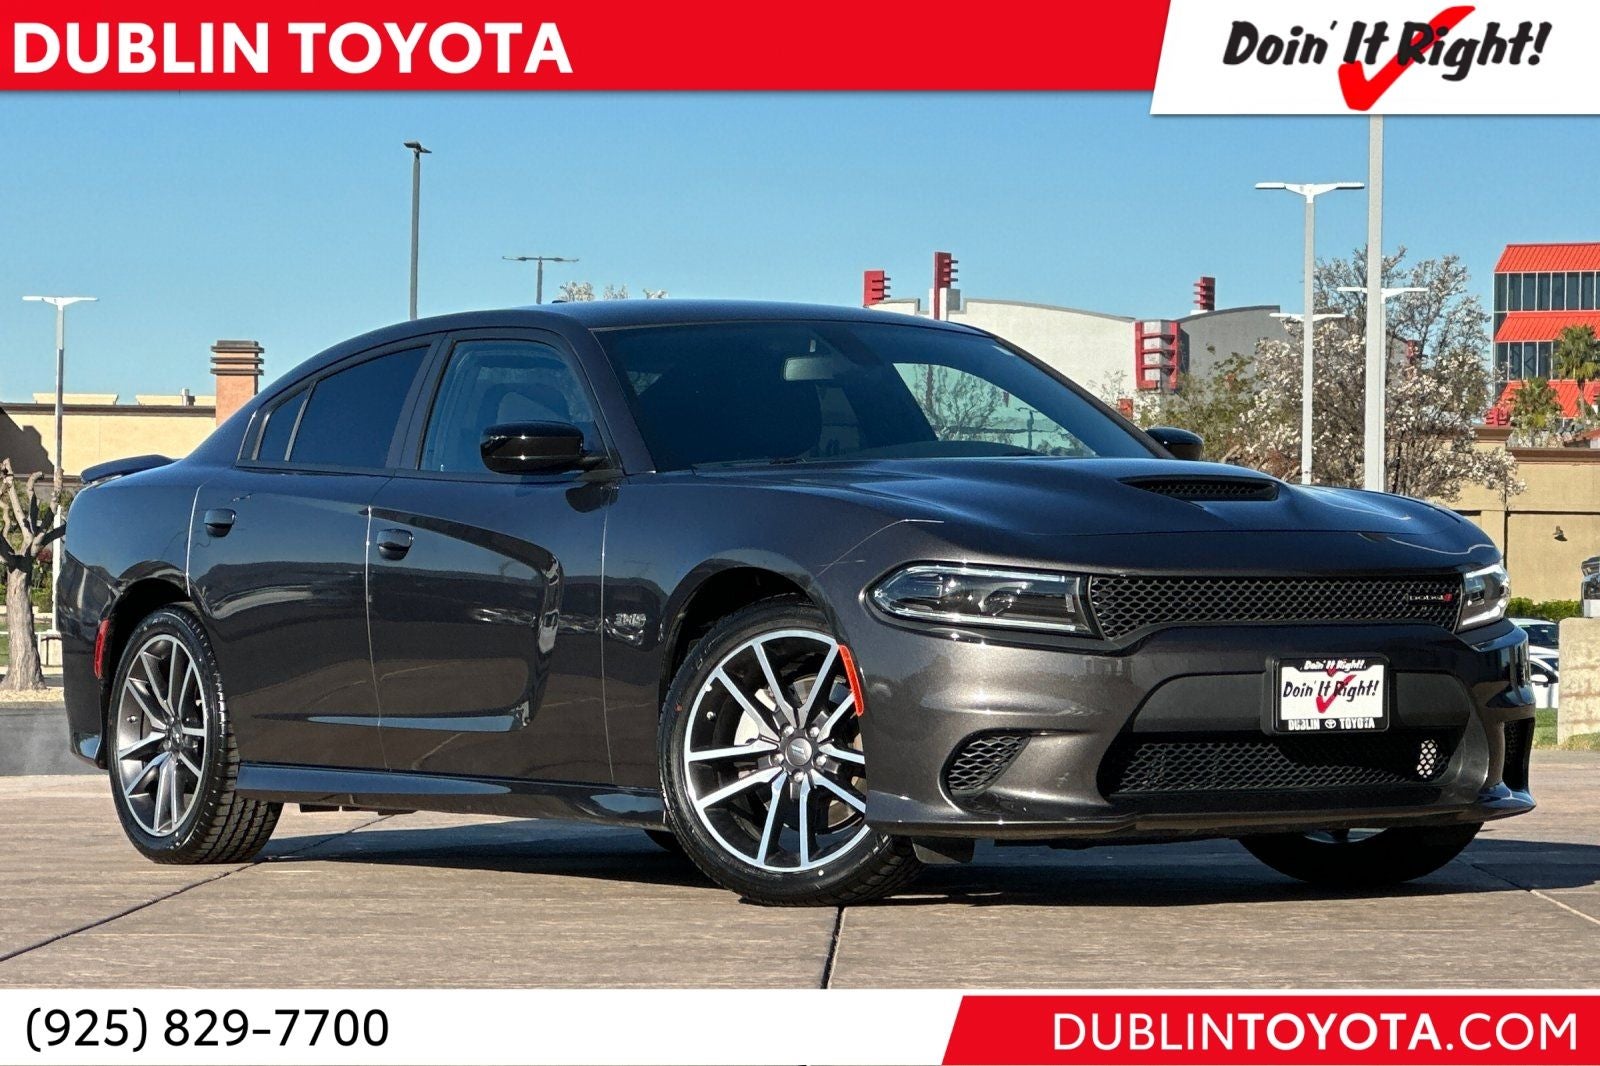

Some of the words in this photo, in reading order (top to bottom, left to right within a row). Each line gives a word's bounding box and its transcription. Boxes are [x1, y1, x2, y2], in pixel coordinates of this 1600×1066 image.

[1283, 680, 1317, 698] Doin'
[1318, 680, 1331, 697] It
[1333, 680, 1380, 702] Right!
[1288, 719, 1320, 730] DUBLIN
[1339, 717, 1375, 730] TOYOTA
